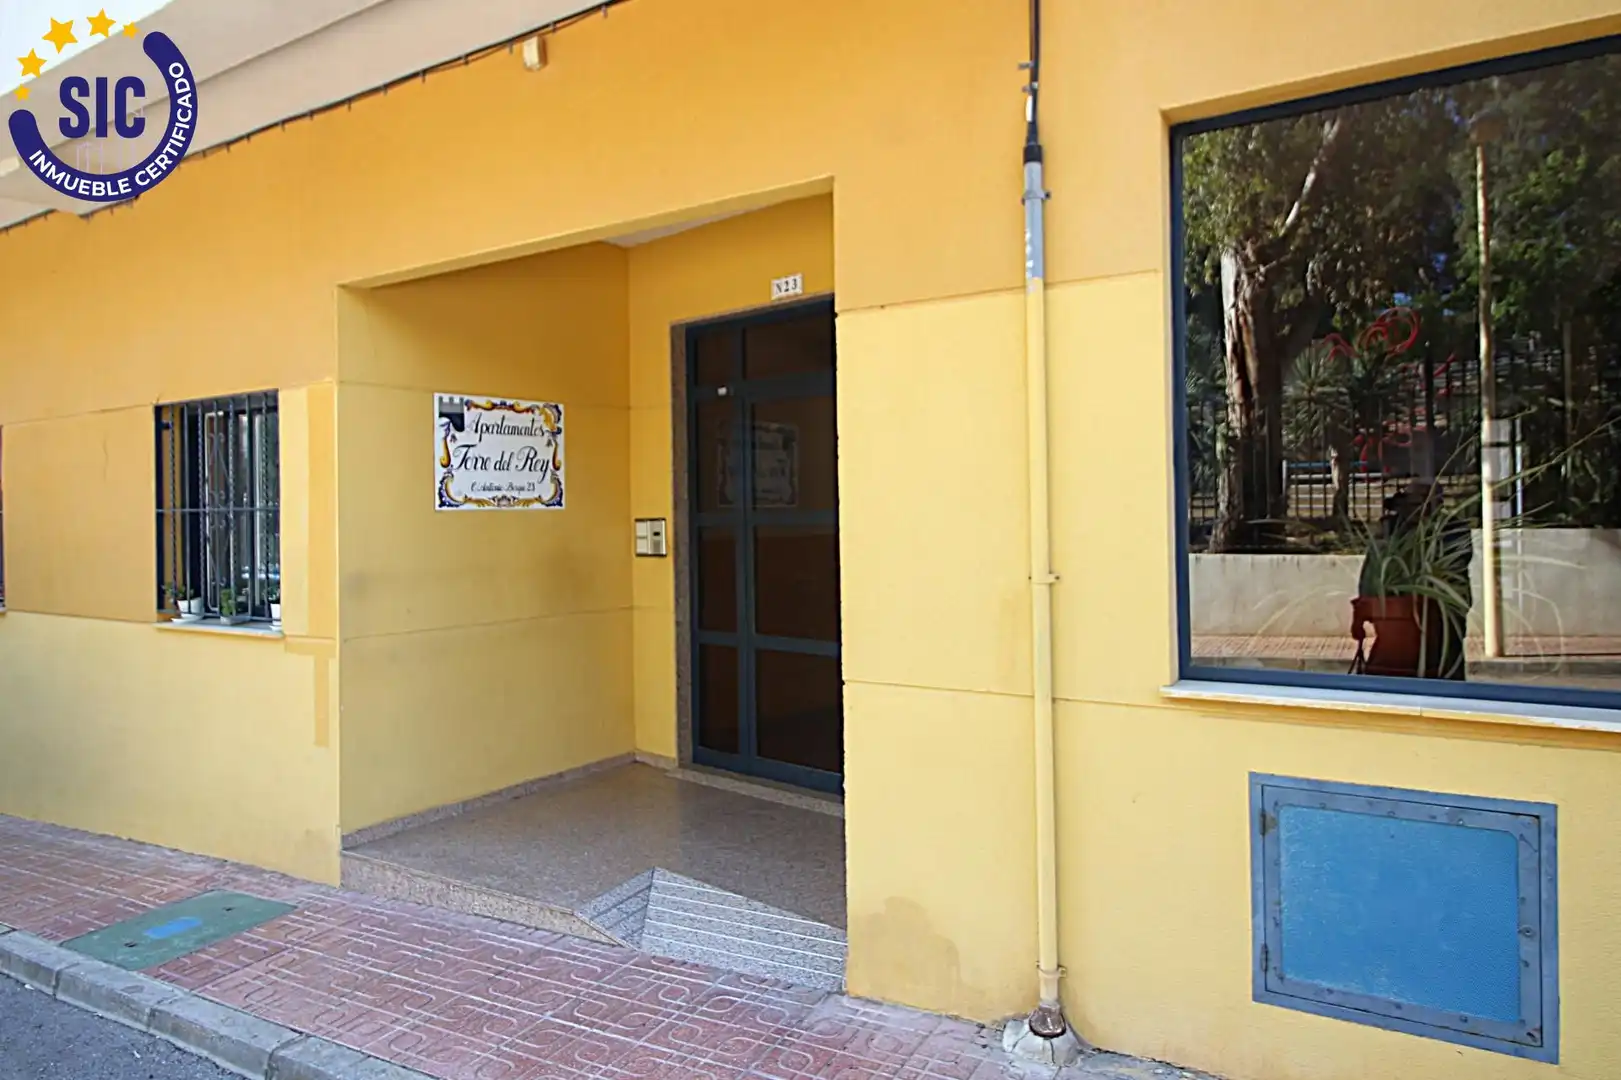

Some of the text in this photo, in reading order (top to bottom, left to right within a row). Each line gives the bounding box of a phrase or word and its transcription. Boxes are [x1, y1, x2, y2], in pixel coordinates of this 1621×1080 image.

[467, 412, 545, 442] Apartamentos
[453, 444, 550, 484] Torre del Rey
